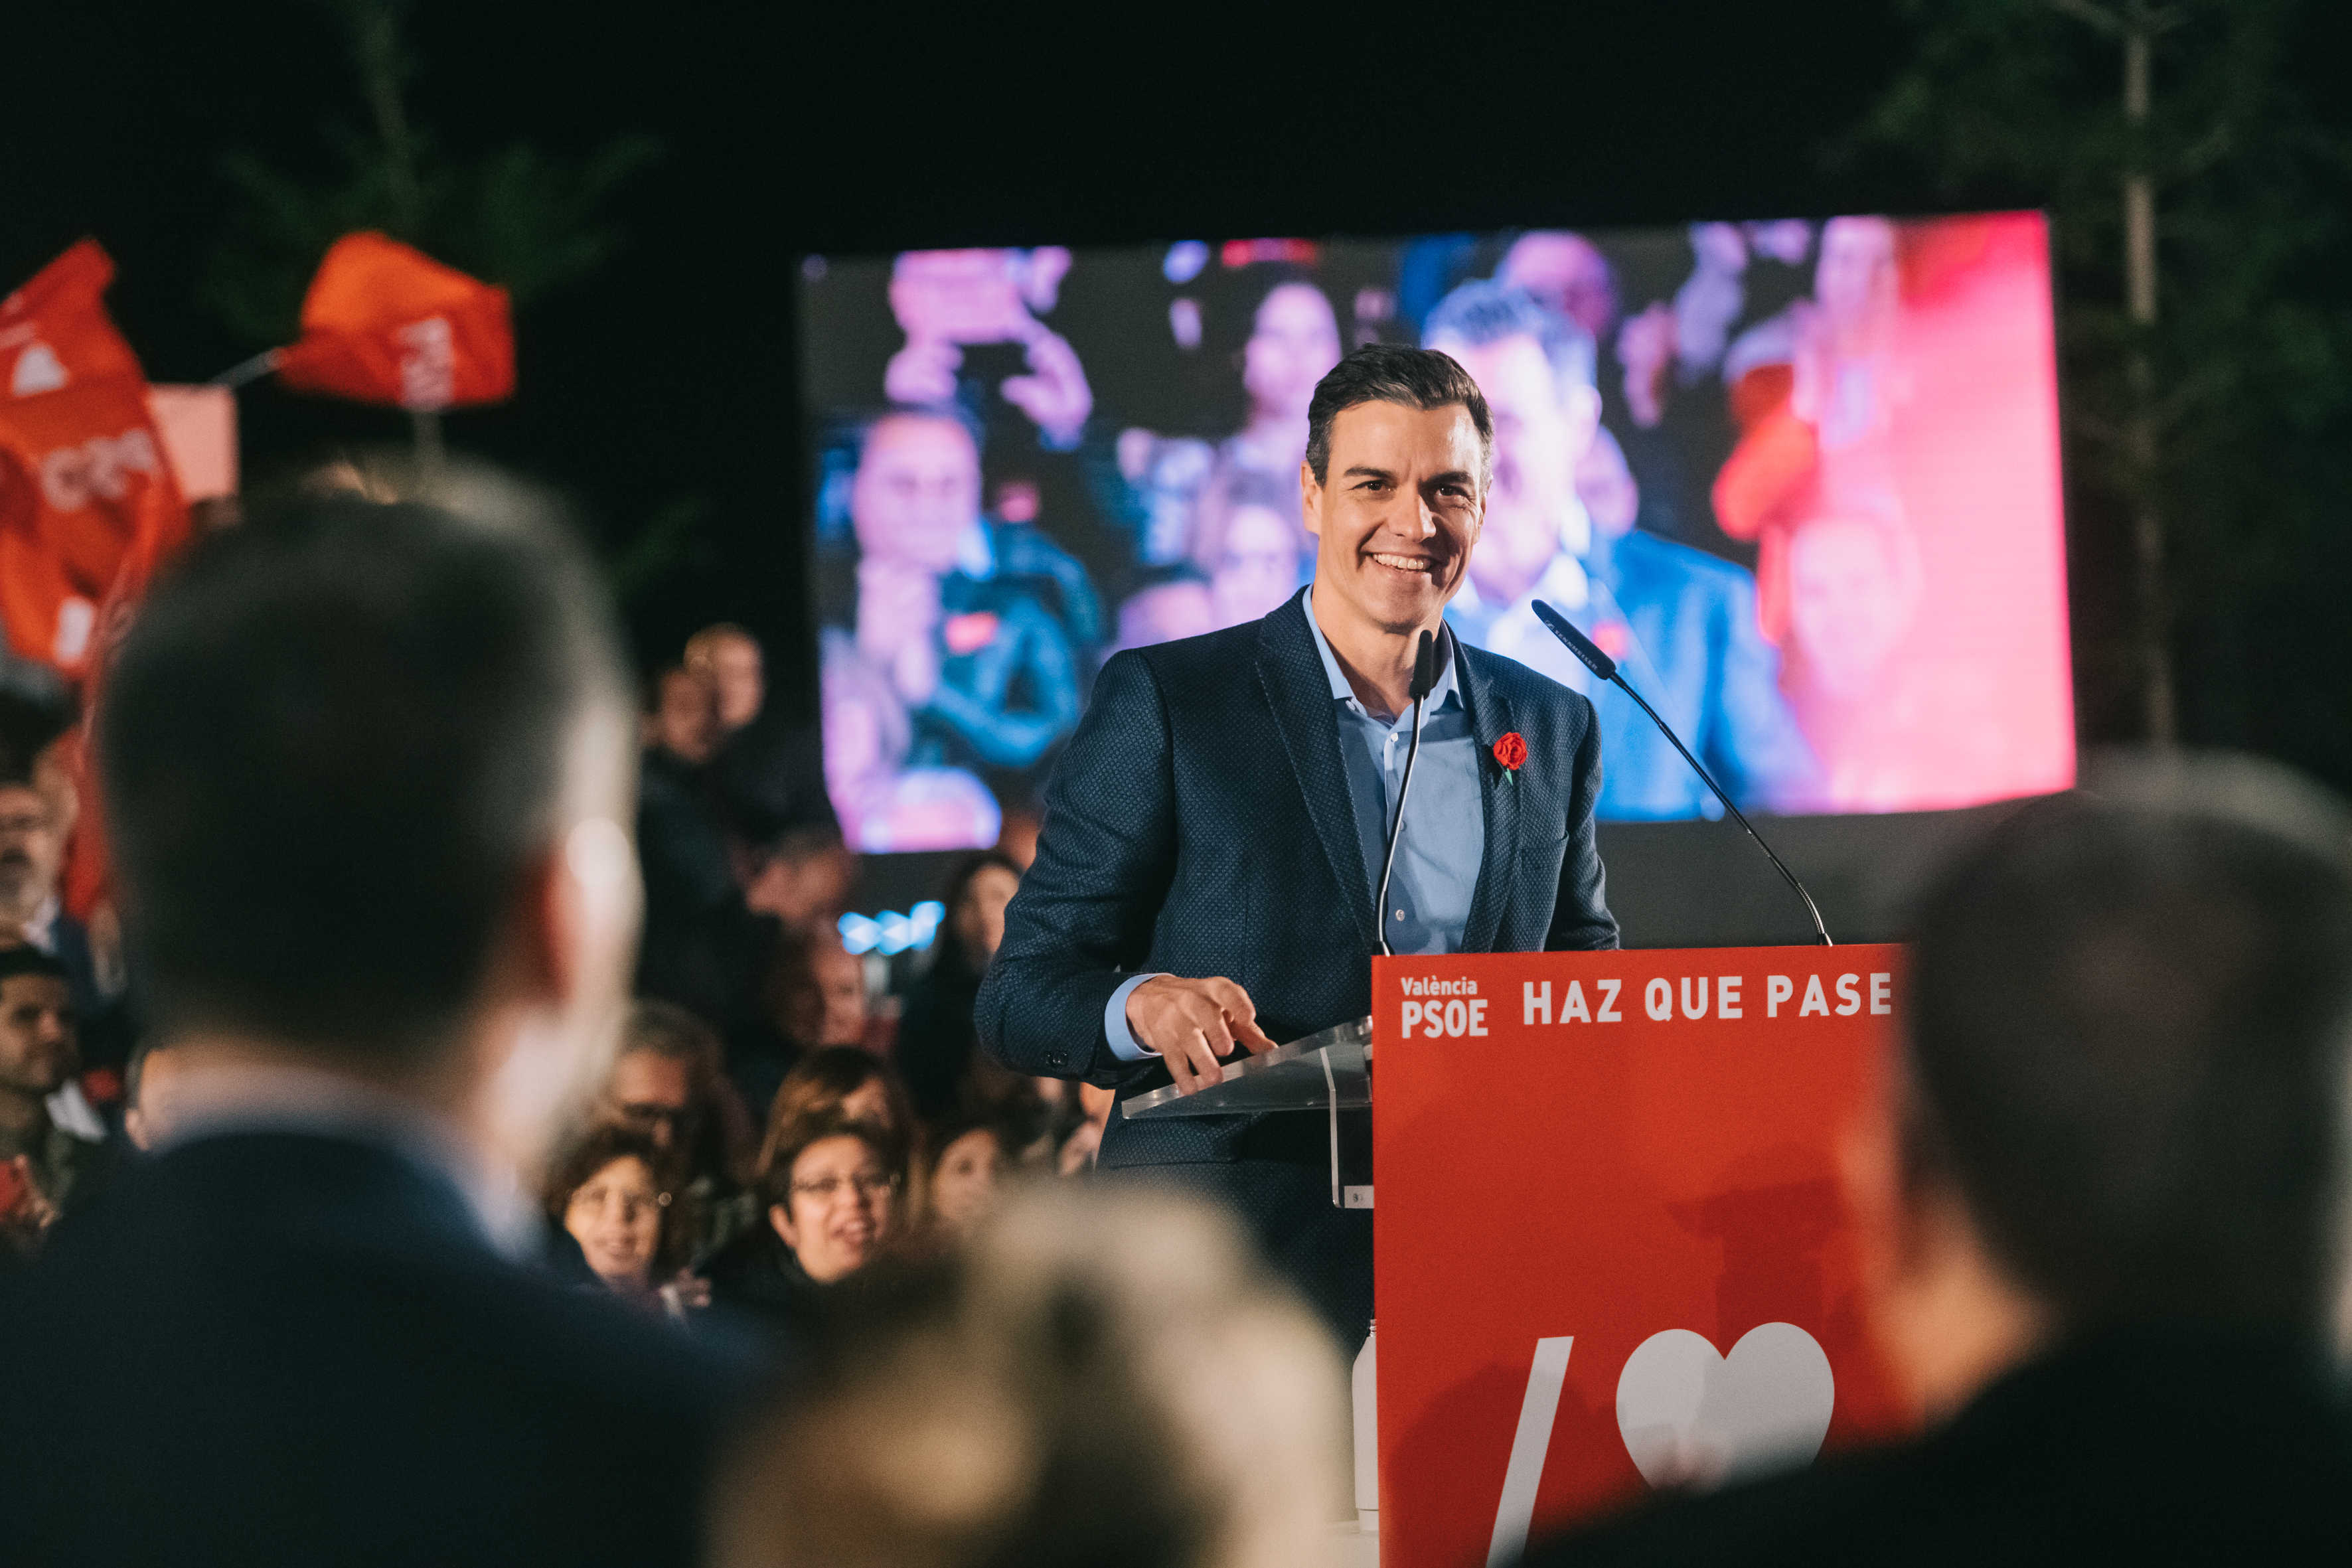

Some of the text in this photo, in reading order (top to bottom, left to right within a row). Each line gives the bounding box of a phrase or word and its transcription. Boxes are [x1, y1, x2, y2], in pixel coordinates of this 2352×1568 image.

[1401, 975, 1478, 996] València
[1523, 973, 1891, 1025] HAZ QUE PASE
[1401, 998, 1488, 1039] PSOE
